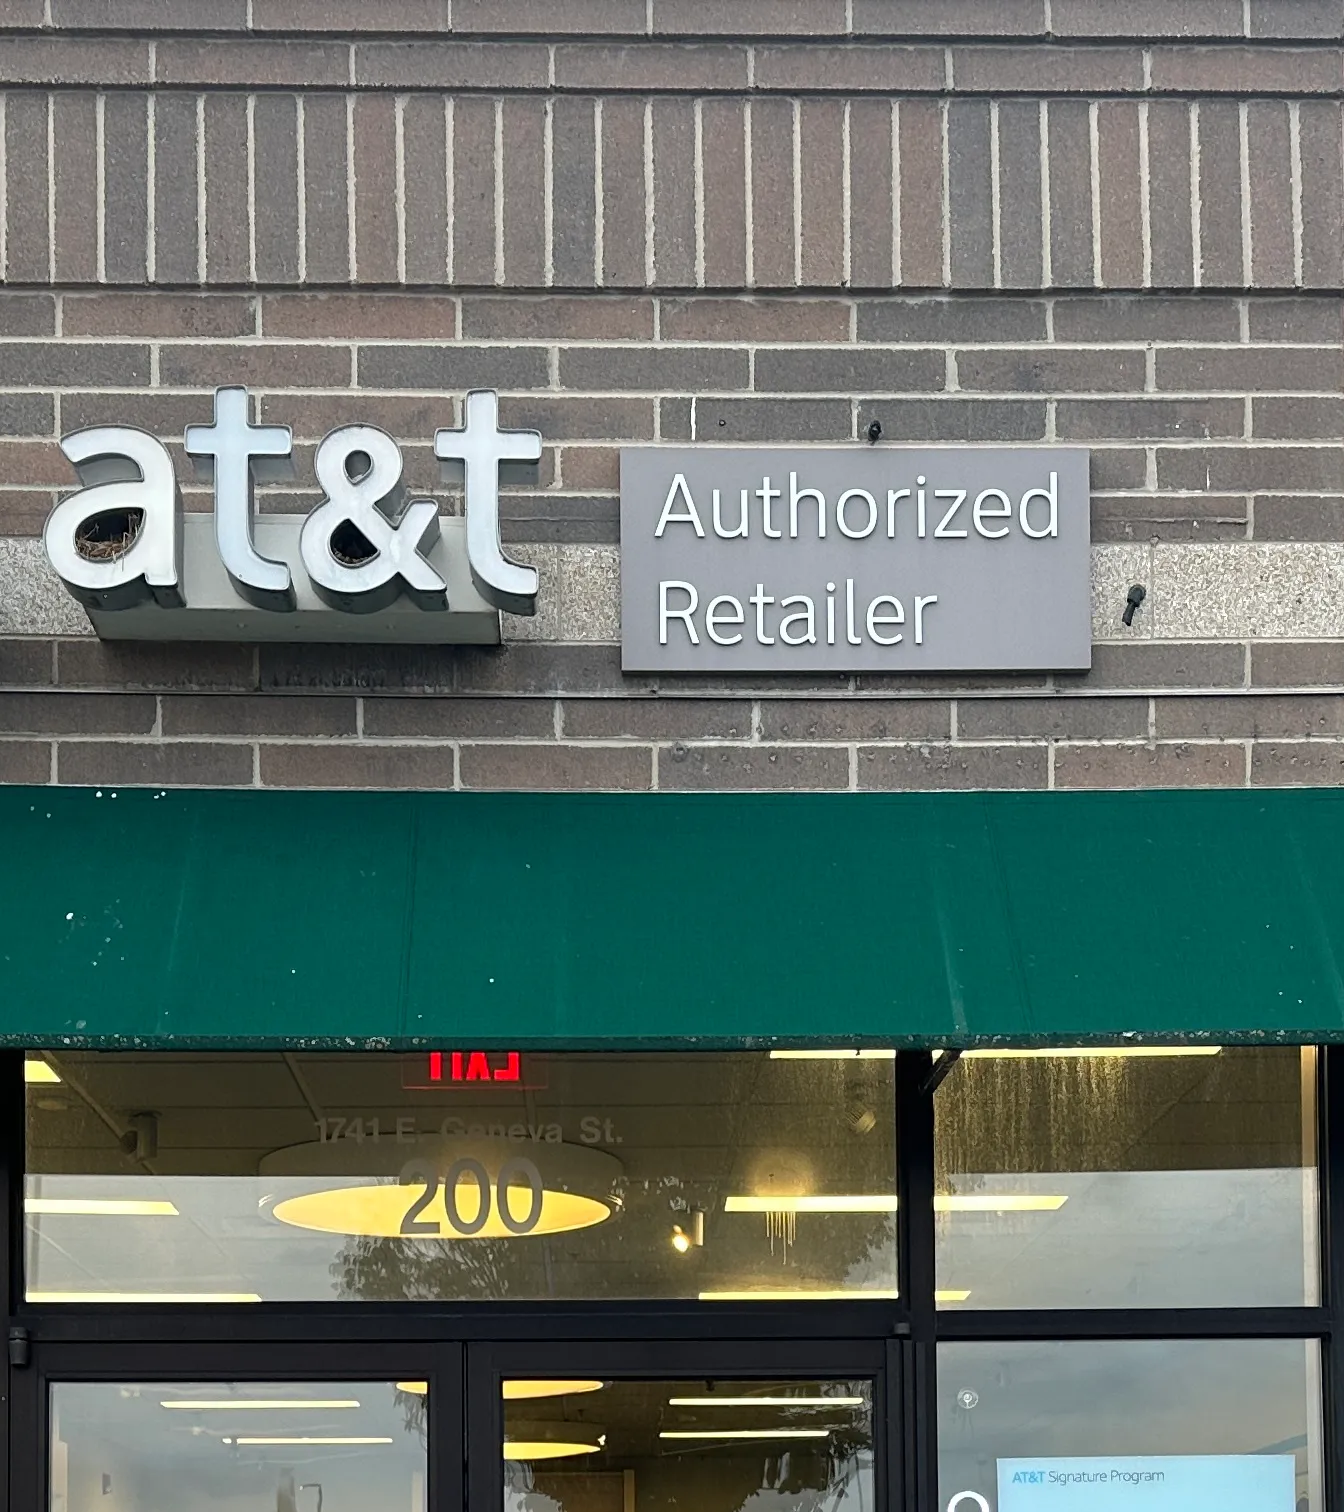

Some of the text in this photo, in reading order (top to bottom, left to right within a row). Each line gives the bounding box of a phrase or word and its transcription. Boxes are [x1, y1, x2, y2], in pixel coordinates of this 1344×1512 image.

[44, 386, 542, 600] at&t
[655, 471, 1060, 541] Authorized
[655, 580, 940, 648] Retailer
[315, 1116, 623, 1143] 1741 E. Geneva St.
[399, 1157, 544, 1235] 200
[1012, 1469, 1165, 1486] AT&T Signature Program
